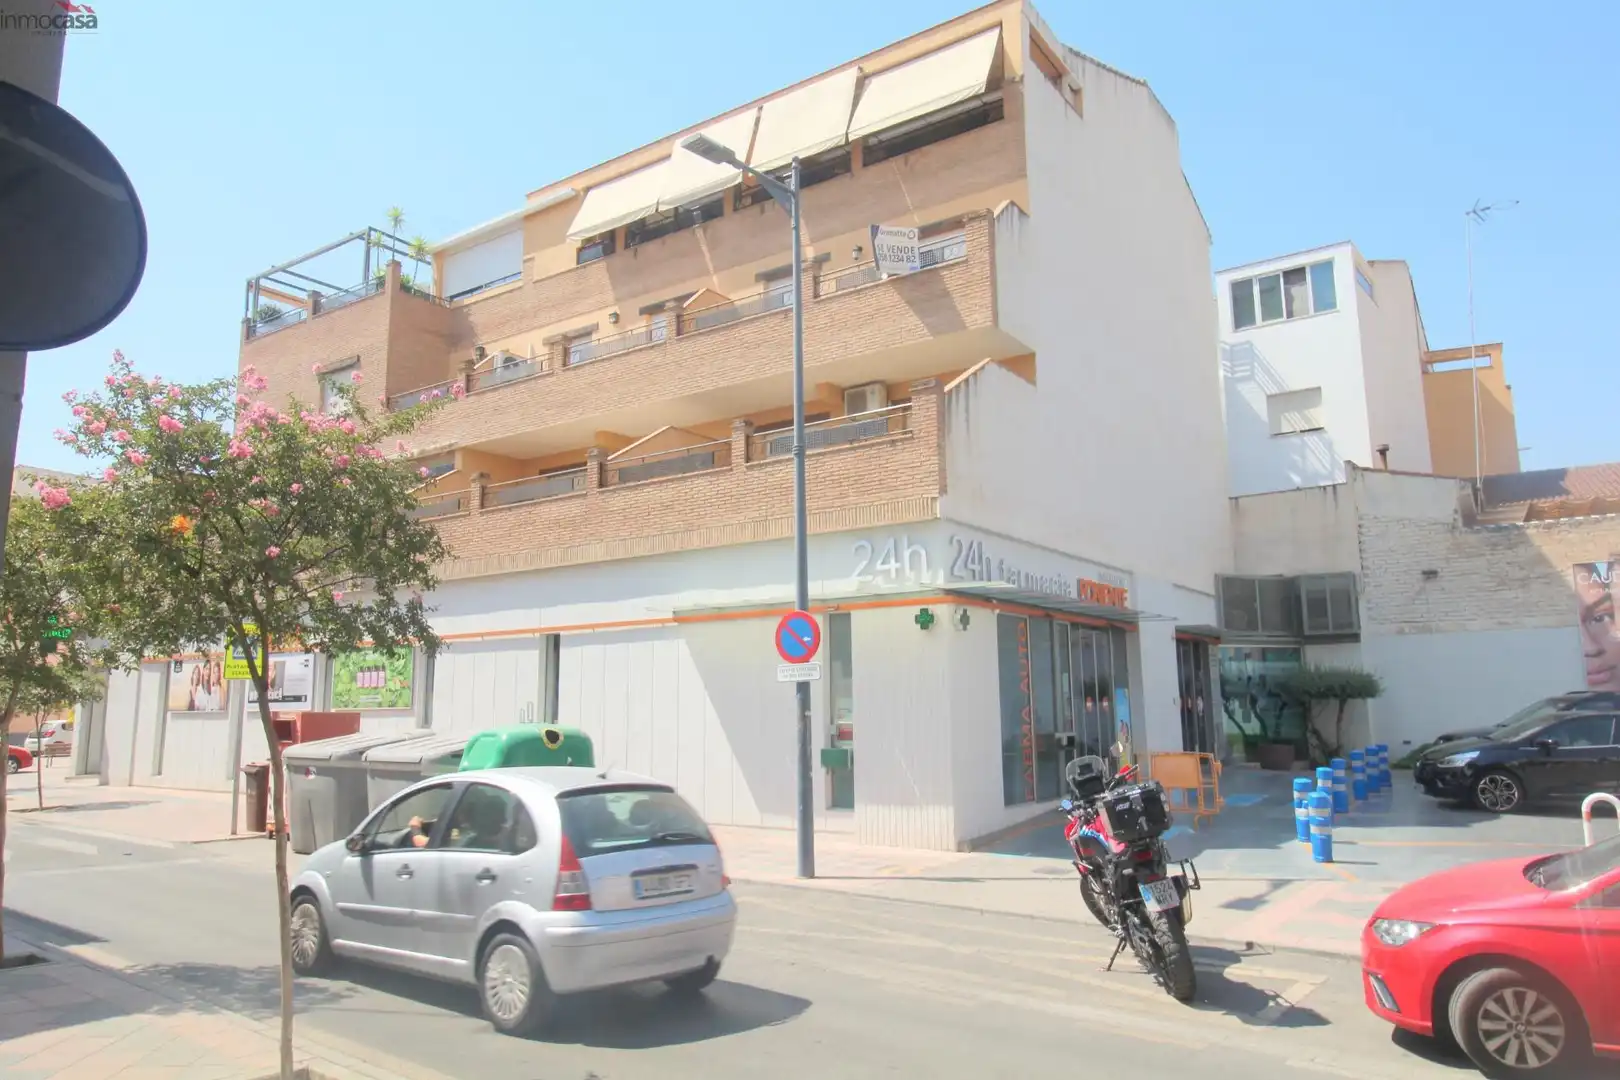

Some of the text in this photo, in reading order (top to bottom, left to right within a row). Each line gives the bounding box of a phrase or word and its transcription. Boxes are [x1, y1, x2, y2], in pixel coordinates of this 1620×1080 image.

[886, 244, 916, 255] VENDE
[905, 255, 917, 263] 82
[848, 535, 930, 583] 24h
[949, 534, 992, 583] 24h
